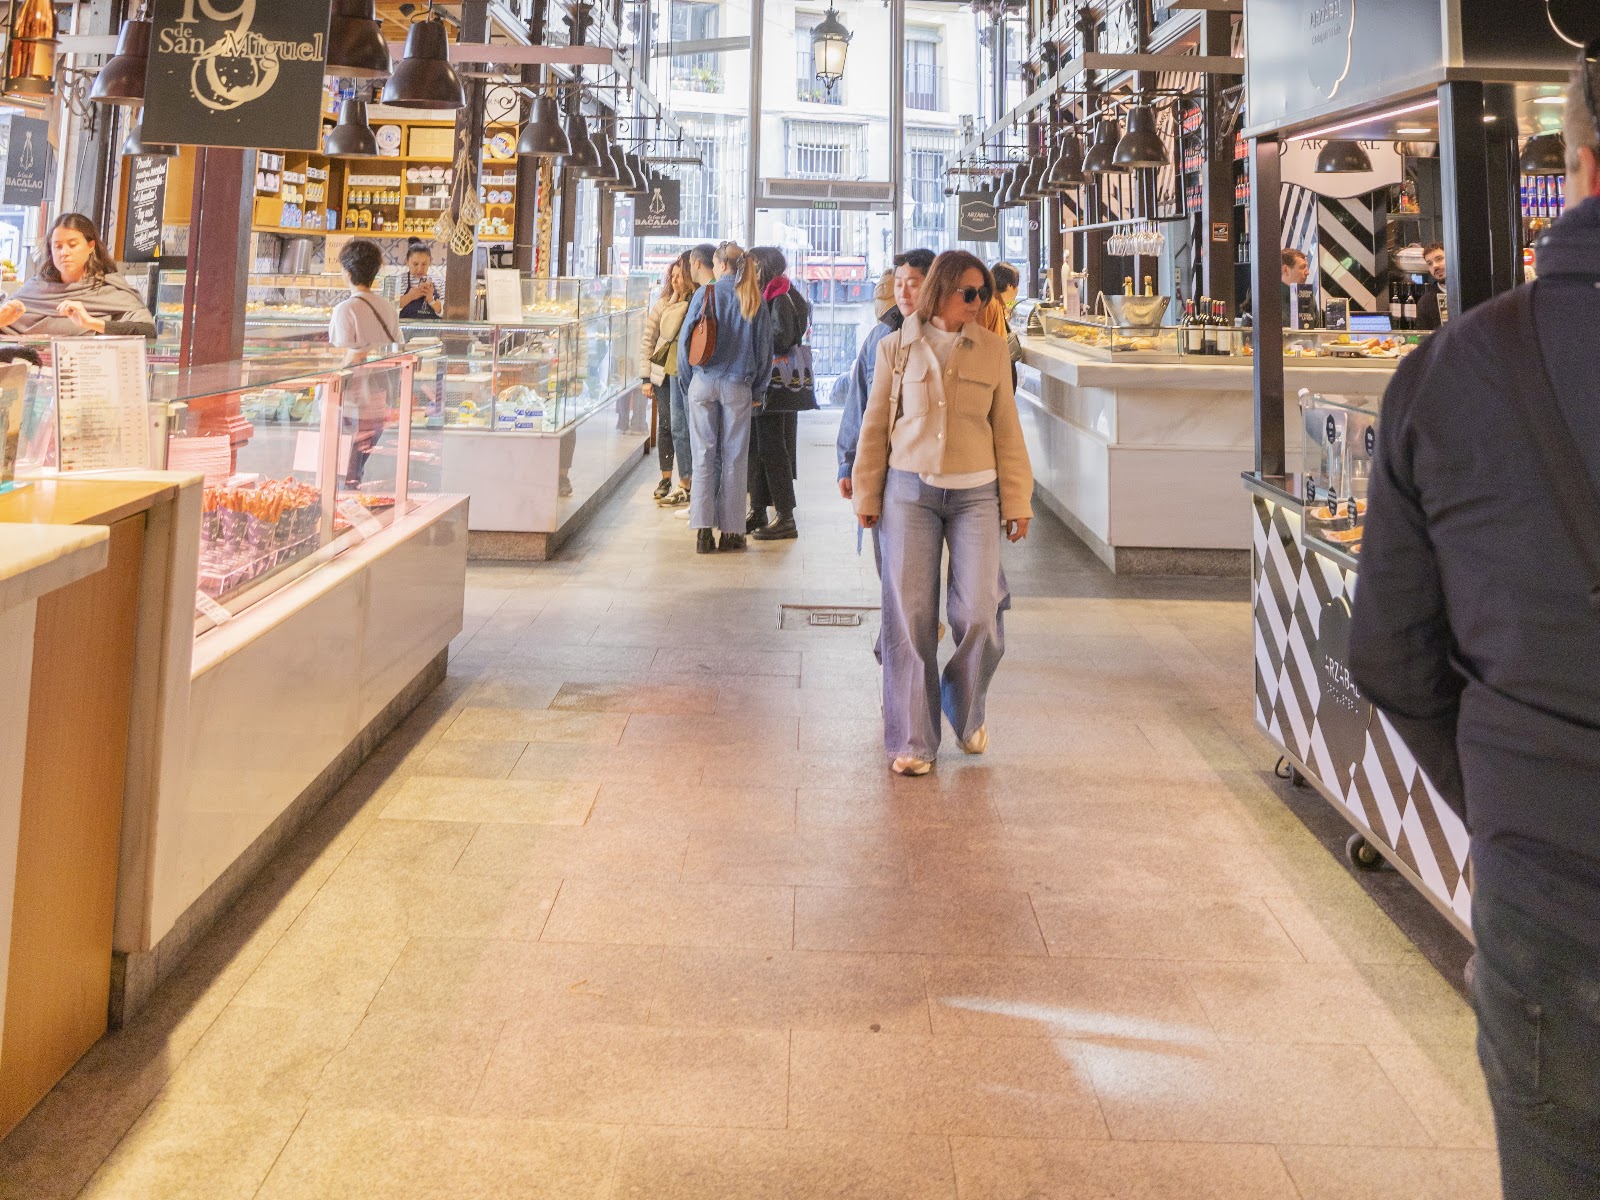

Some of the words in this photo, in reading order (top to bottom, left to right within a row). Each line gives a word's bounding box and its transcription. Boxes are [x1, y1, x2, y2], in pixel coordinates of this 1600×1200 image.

[174, 22, 193, 39] de
[158, 28, 206, 55] San
[221, 29, 324, 71] Miguel
[5, 177, 43, 189] BACALAO
